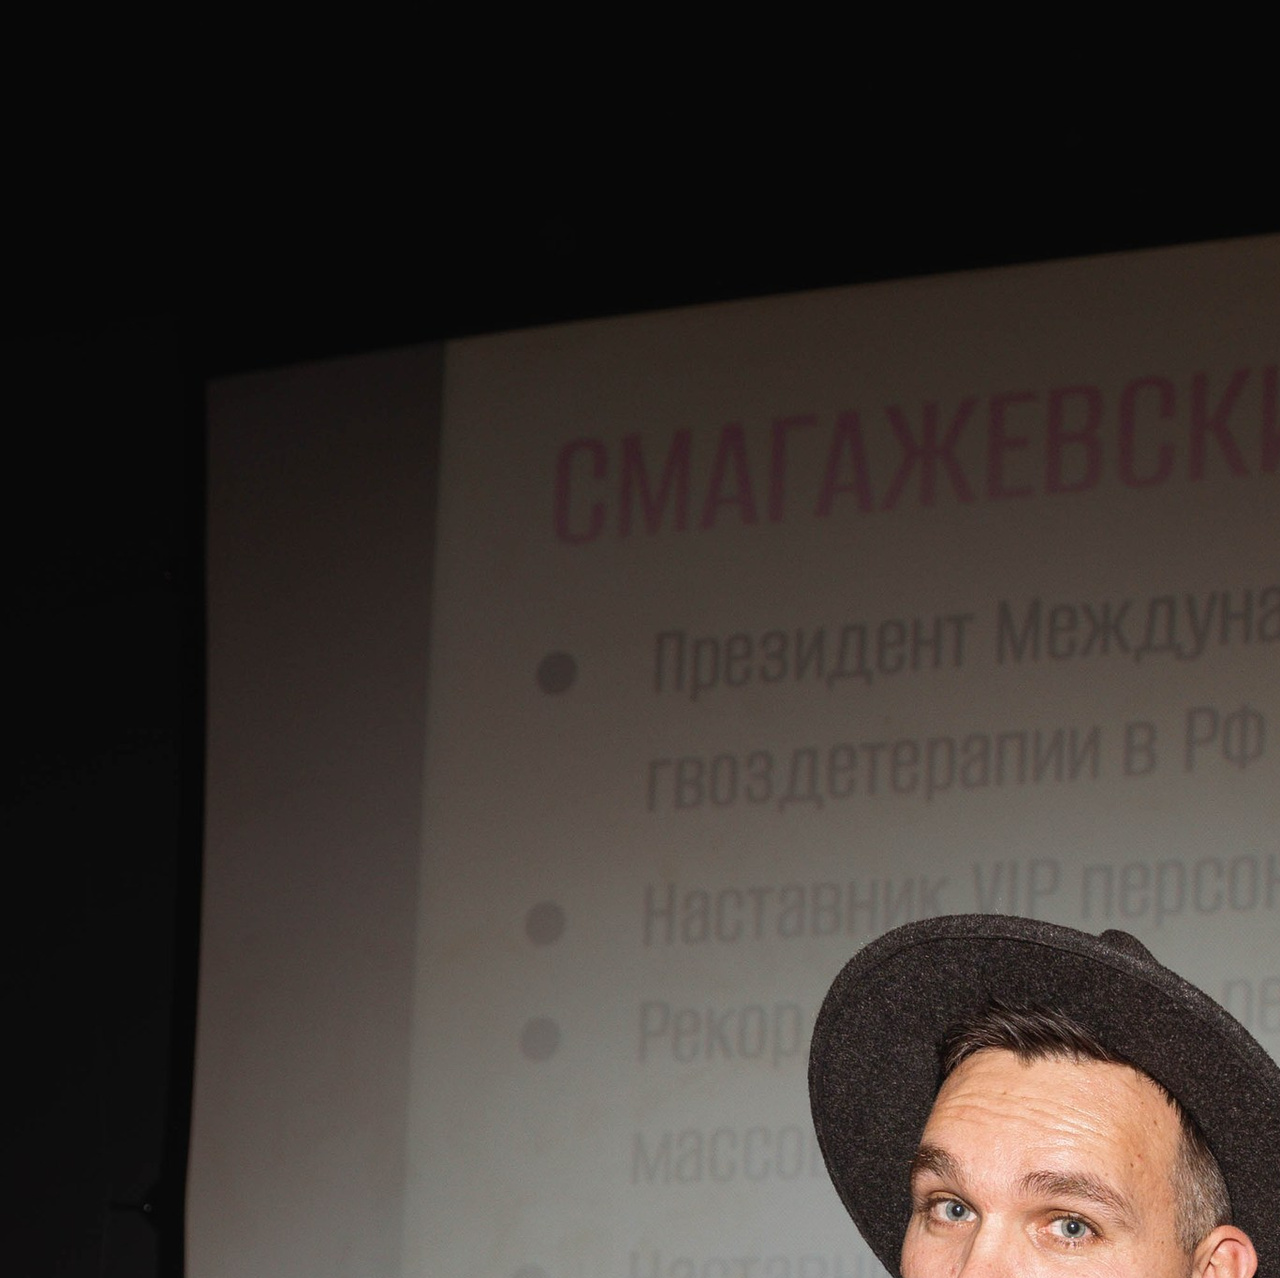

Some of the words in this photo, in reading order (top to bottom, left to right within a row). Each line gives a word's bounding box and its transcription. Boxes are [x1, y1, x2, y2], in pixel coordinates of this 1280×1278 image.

[653, 610, 976, 699] Президент
[646, 726, 1101, 812] гвоздетерапии
[1123, 719, 1158, 777] в
[1183, 701, 1266, 774] РФ
[642, 875, 949, 947] Наставник
[970, 857, 1062, 915] VIP
[637, 999, 806, 1069] Рекор
[630, 1124, 824, 1187] массо
